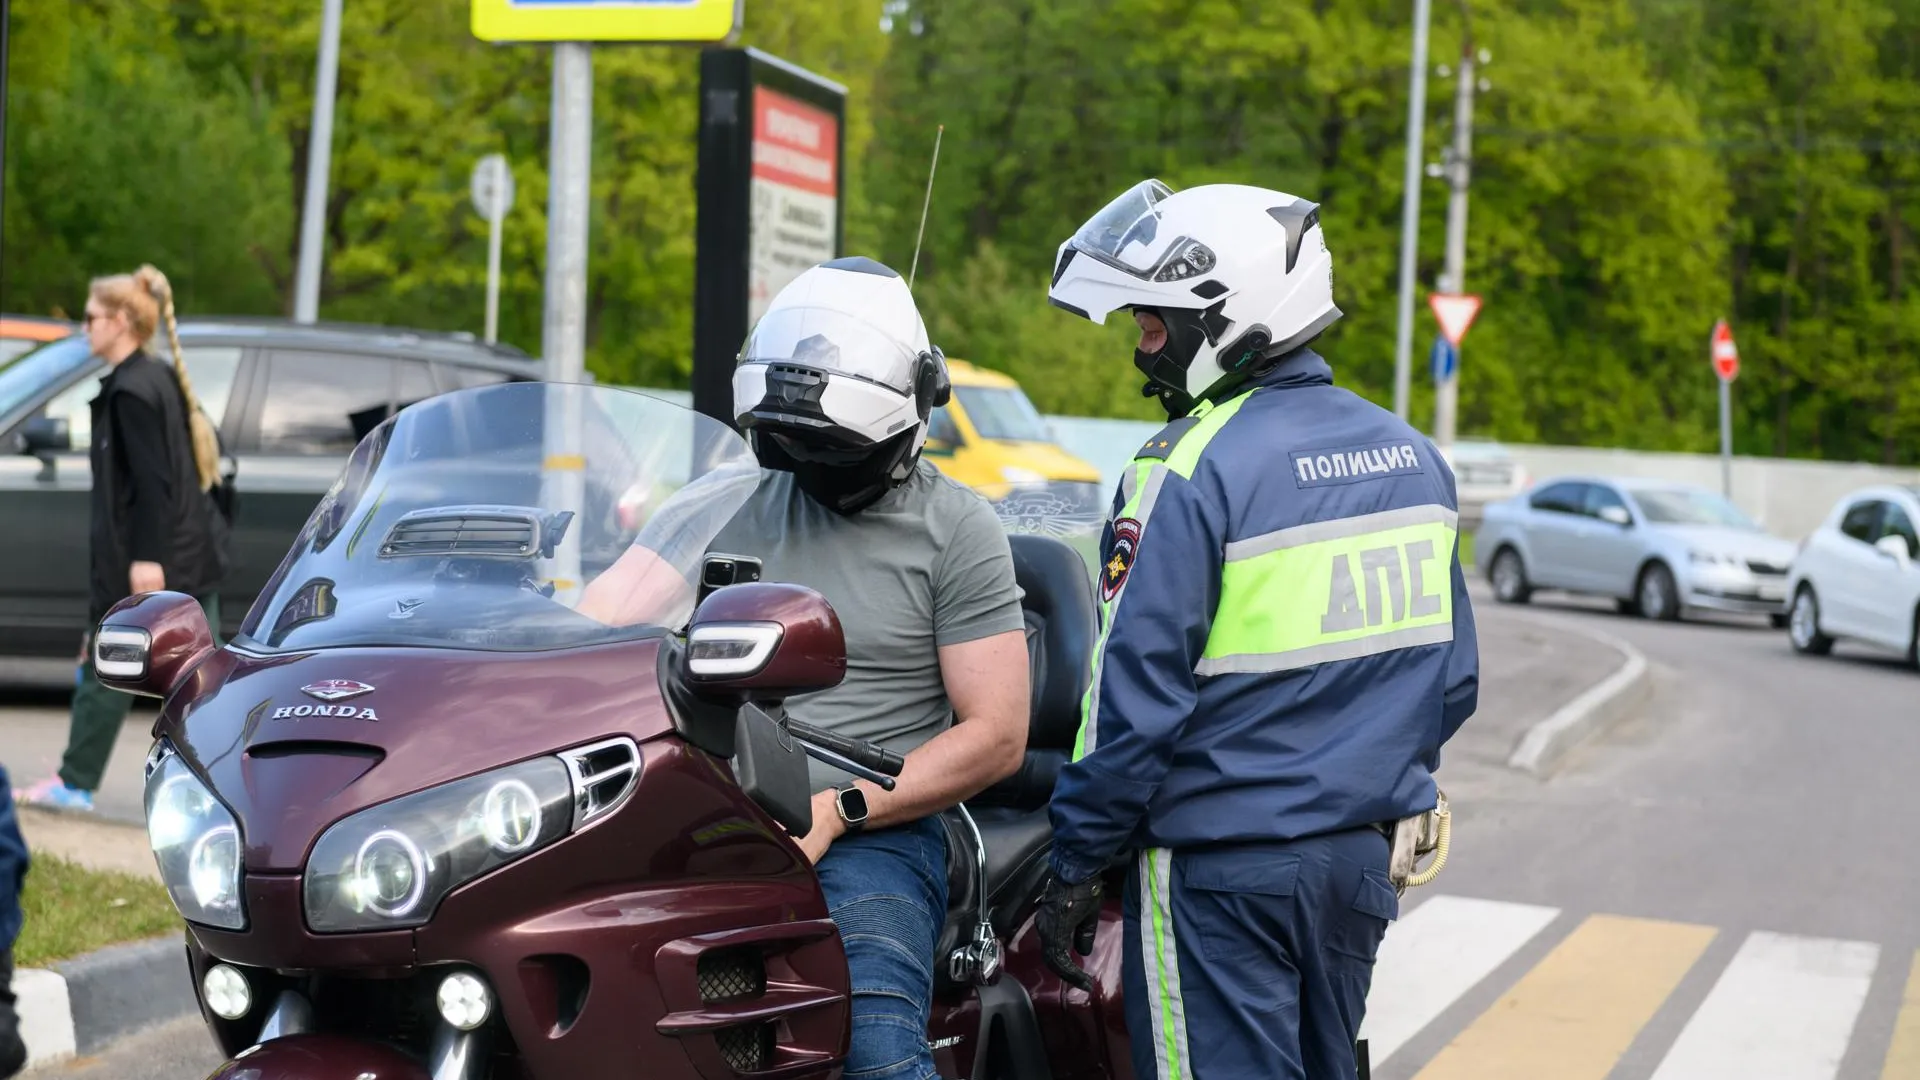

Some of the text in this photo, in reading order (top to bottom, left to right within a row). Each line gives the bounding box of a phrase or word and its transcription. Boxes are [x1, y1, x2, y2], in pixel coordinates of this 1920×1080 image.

[1296, 445, 1419, 481] ПОЛИЦИЯ
[1321, 539, 1442, 634] ДПС
[272, 705, 379, 721] HONDA
